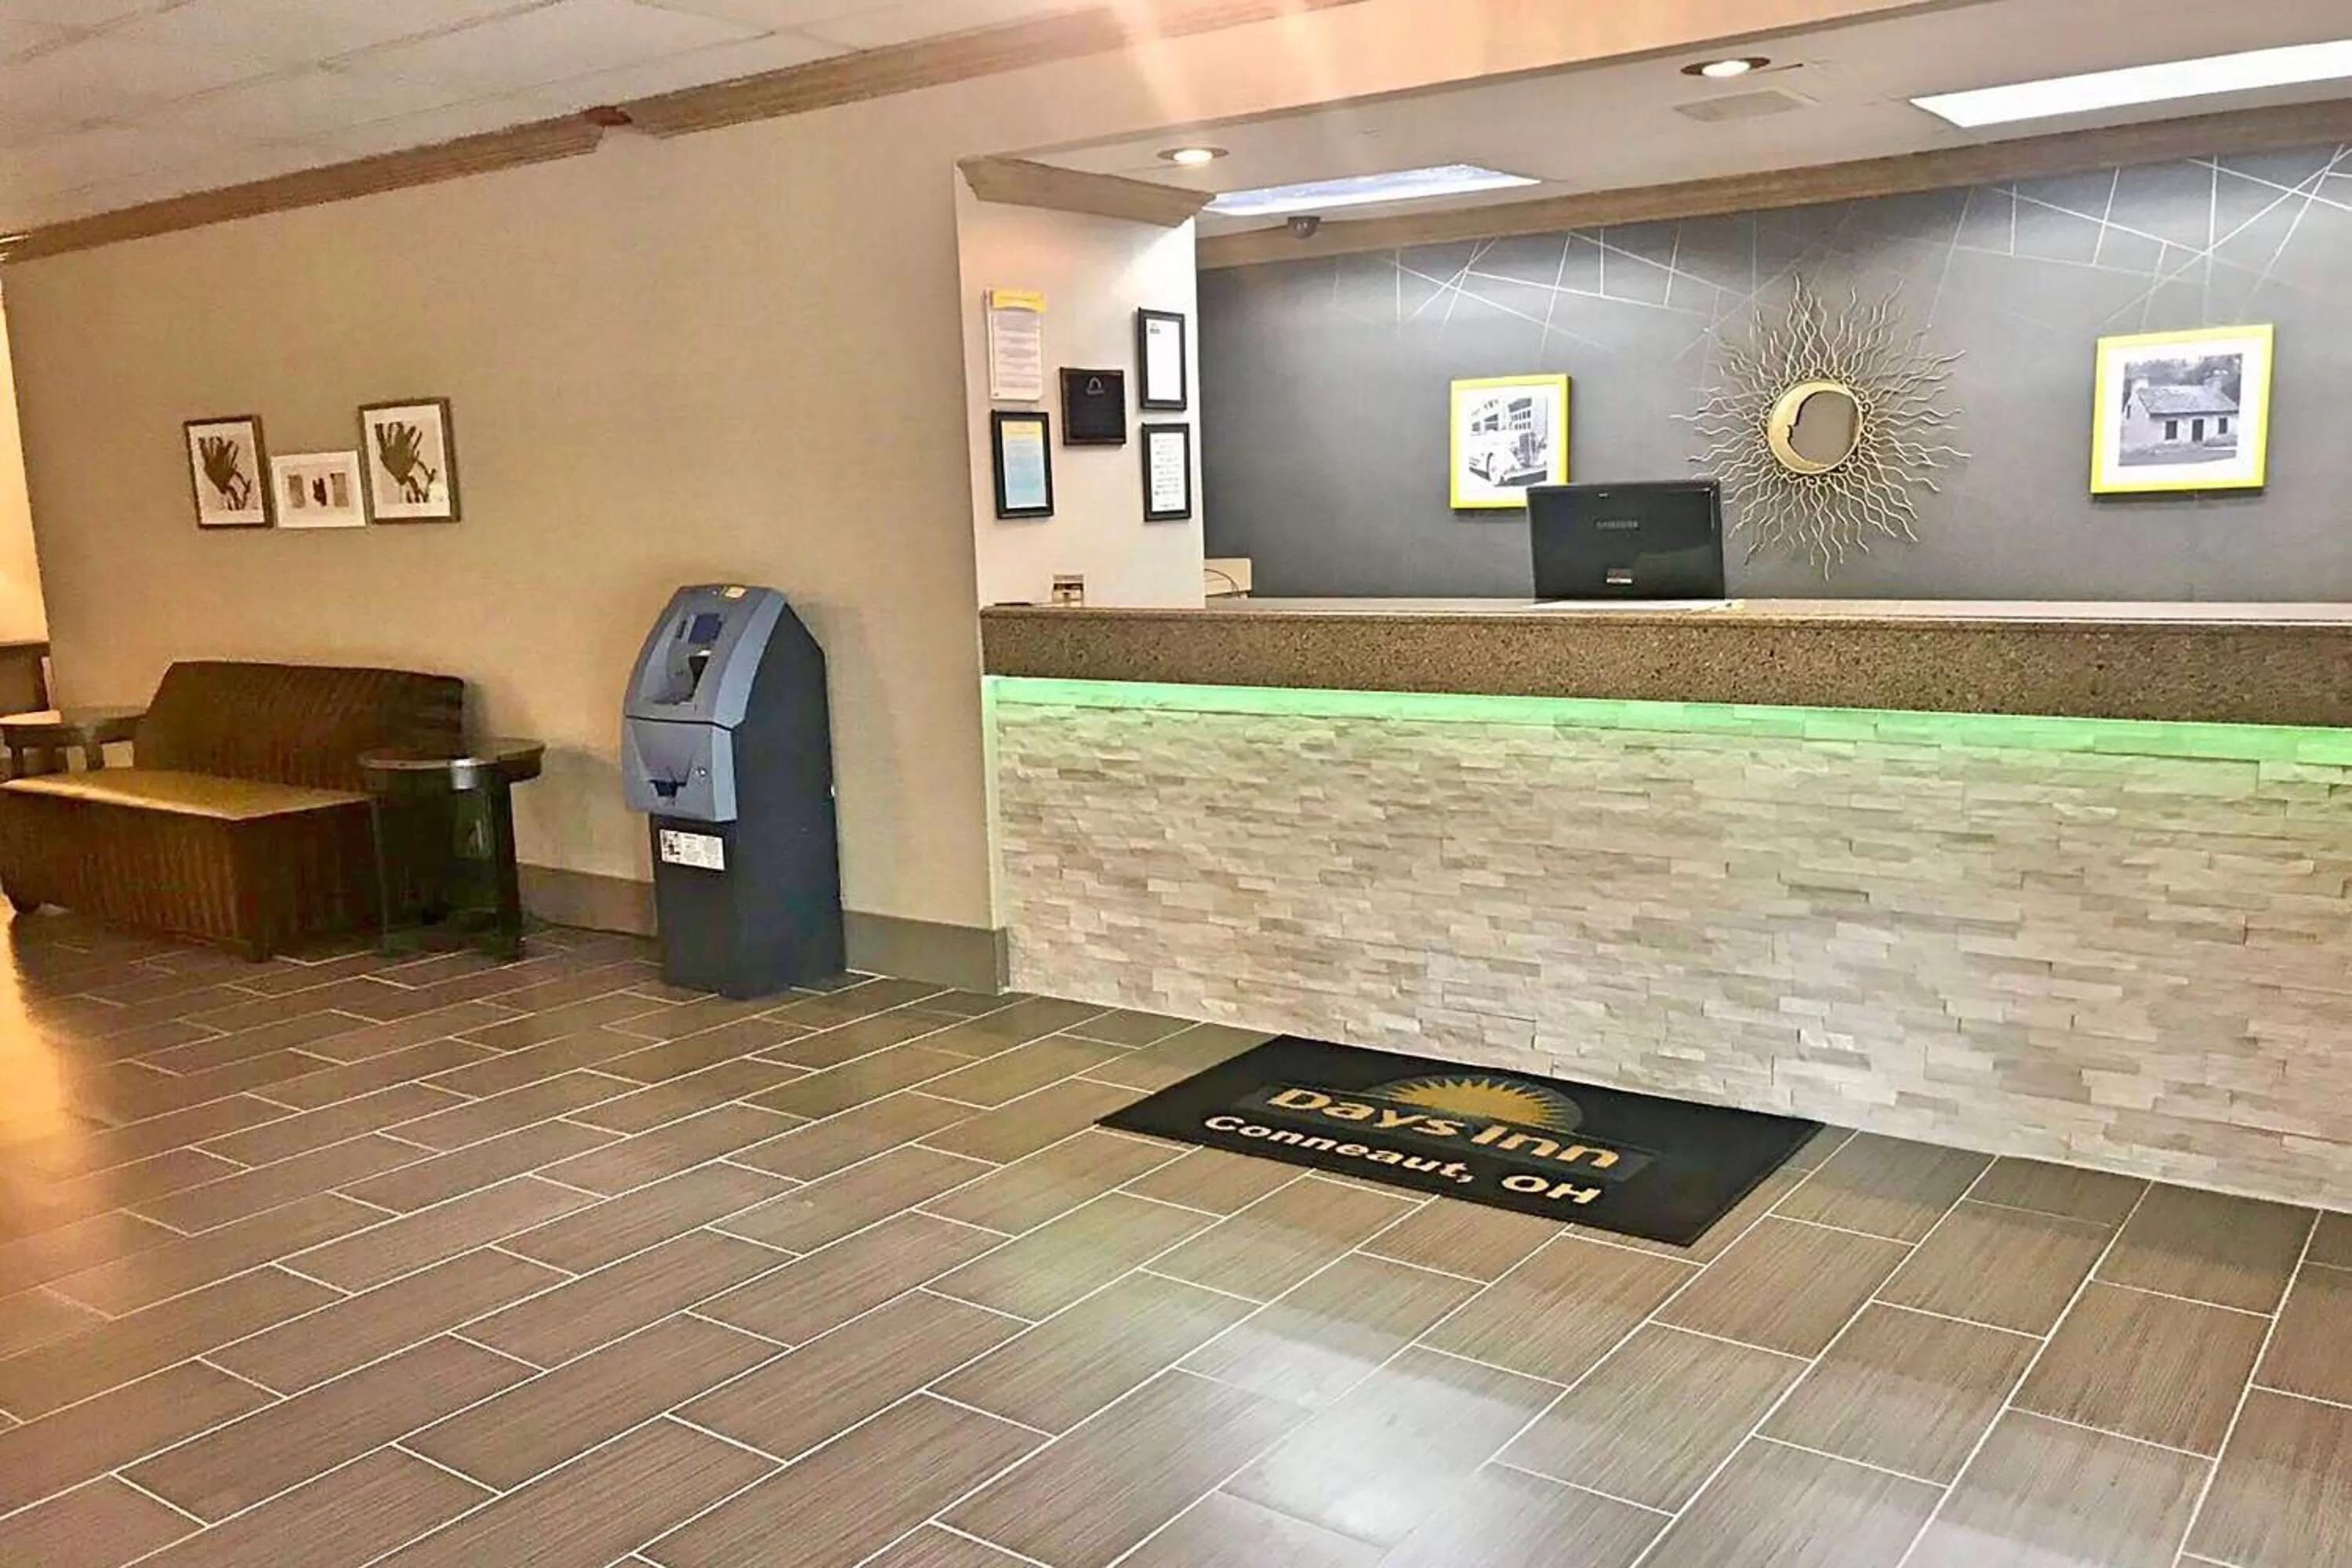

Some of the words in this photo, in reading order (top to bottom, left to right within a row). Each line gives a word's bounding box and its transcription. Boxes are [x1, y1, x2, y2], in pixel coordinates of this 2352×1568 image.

[1204, 1116, 1475, 1183] Conneaut,
[1501, 1175, 1602, 1204] OH
[1266, 1088, 1466, 1136] Days
[1470, 1123, 1619, 1168] Inn
